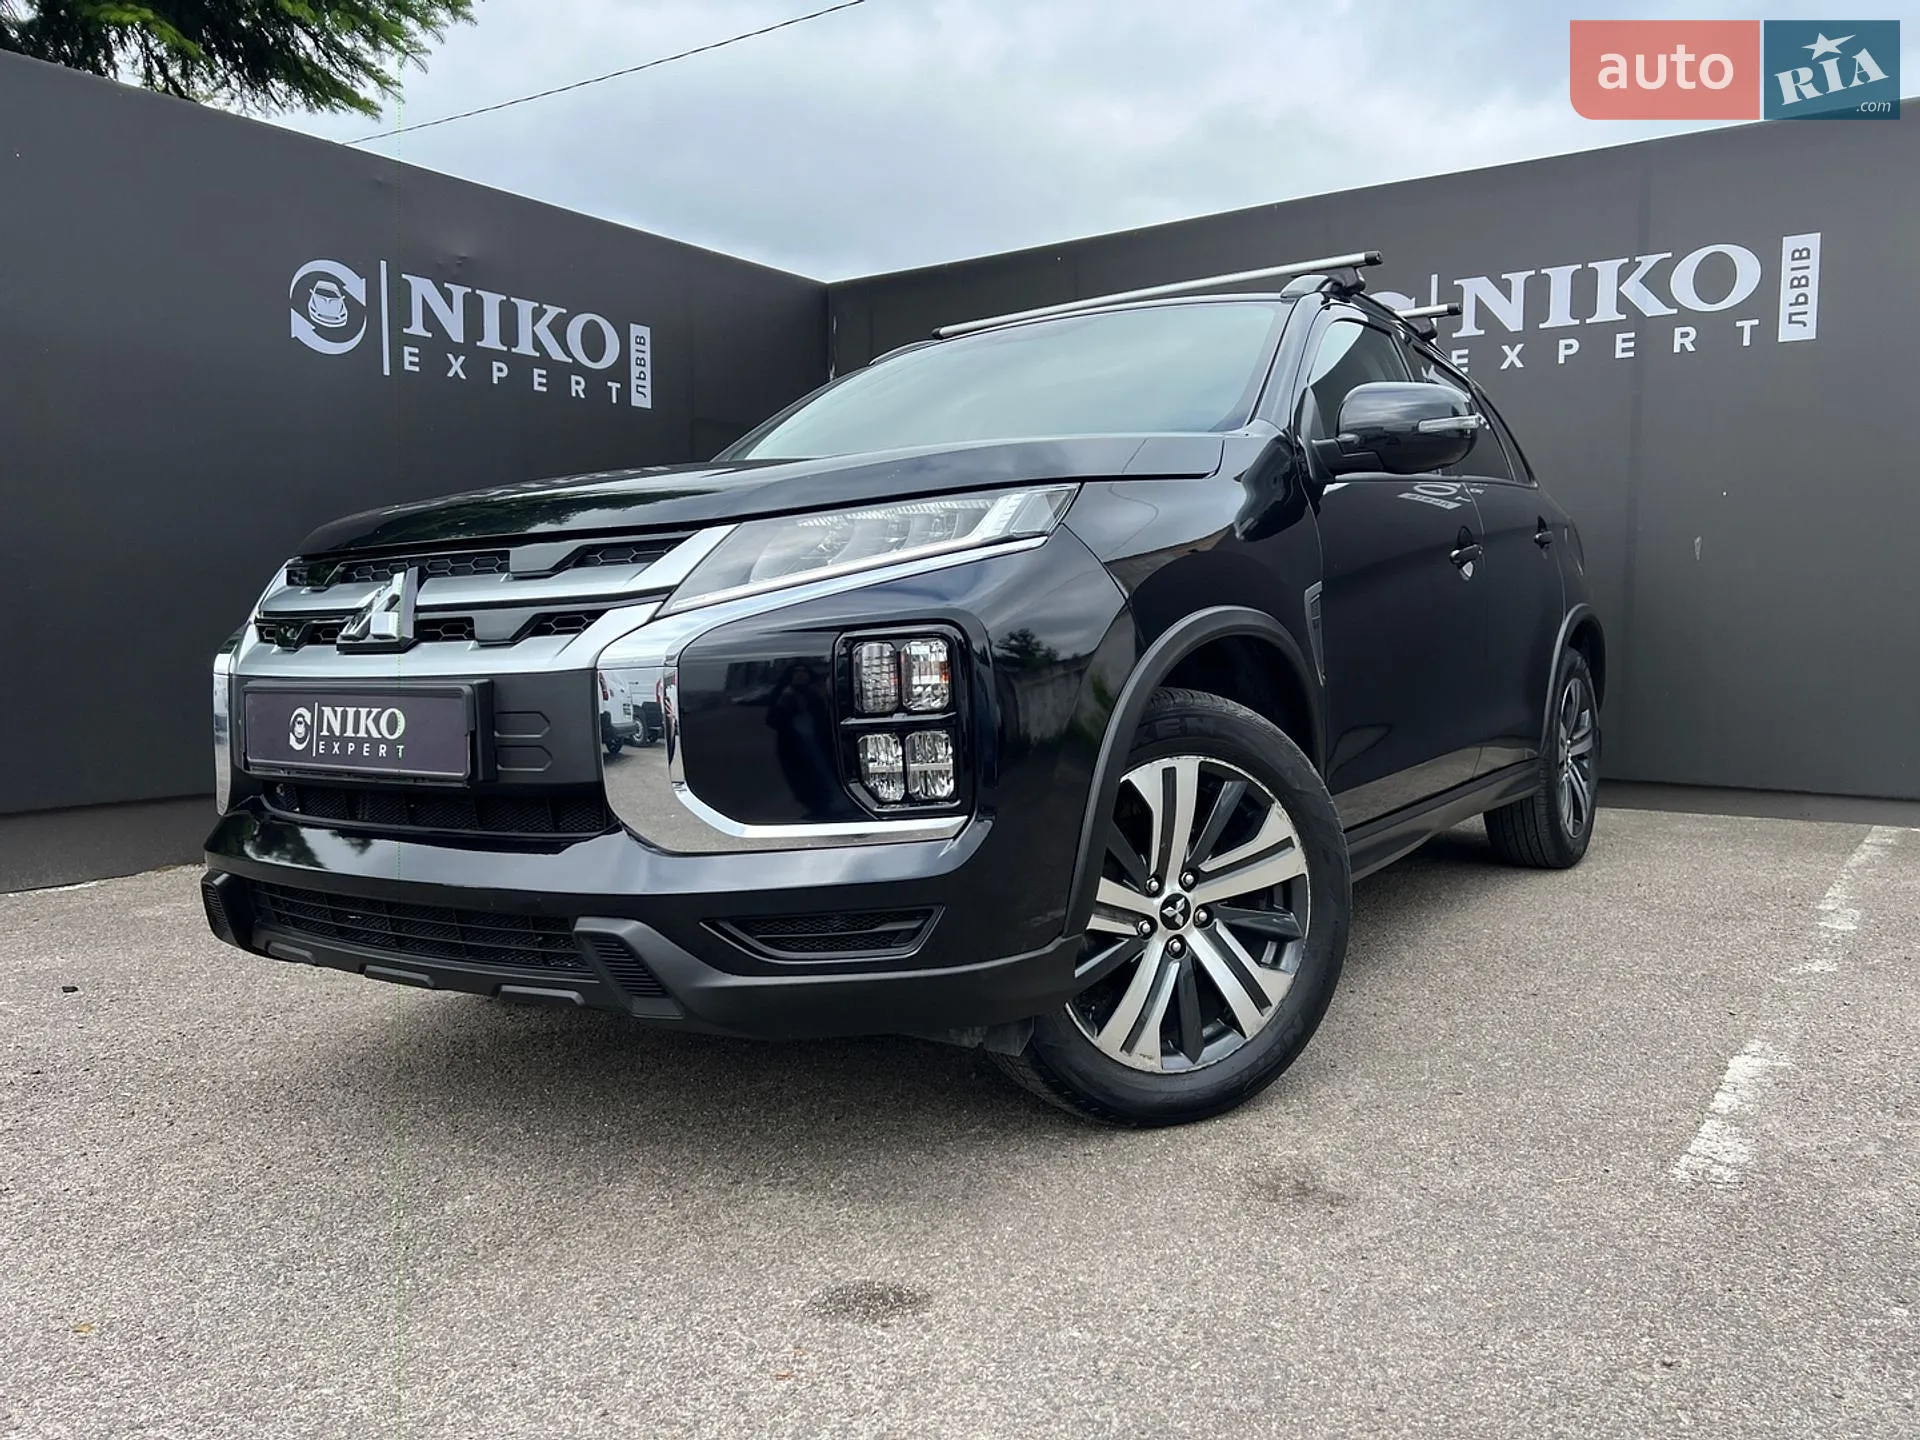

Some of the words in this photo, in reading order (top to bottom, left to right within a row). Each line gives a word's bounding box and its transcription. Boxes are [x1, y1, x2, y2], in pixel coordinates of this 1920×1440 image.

[1452, 243, 1762, 339] NIKO
[1787, 245, 1812, 328] ЛЬВІВ
[401, 273, 621, 371] NIKO
[1451, 318, 1761, 374] EXPERT
[403, 346, 622, 405] EXPERT
[634, 333, 648, 399] ЛЬВІВ
[318, 741, 405, 759] EXPERT
[319, 706, 407, 740] NIKO
